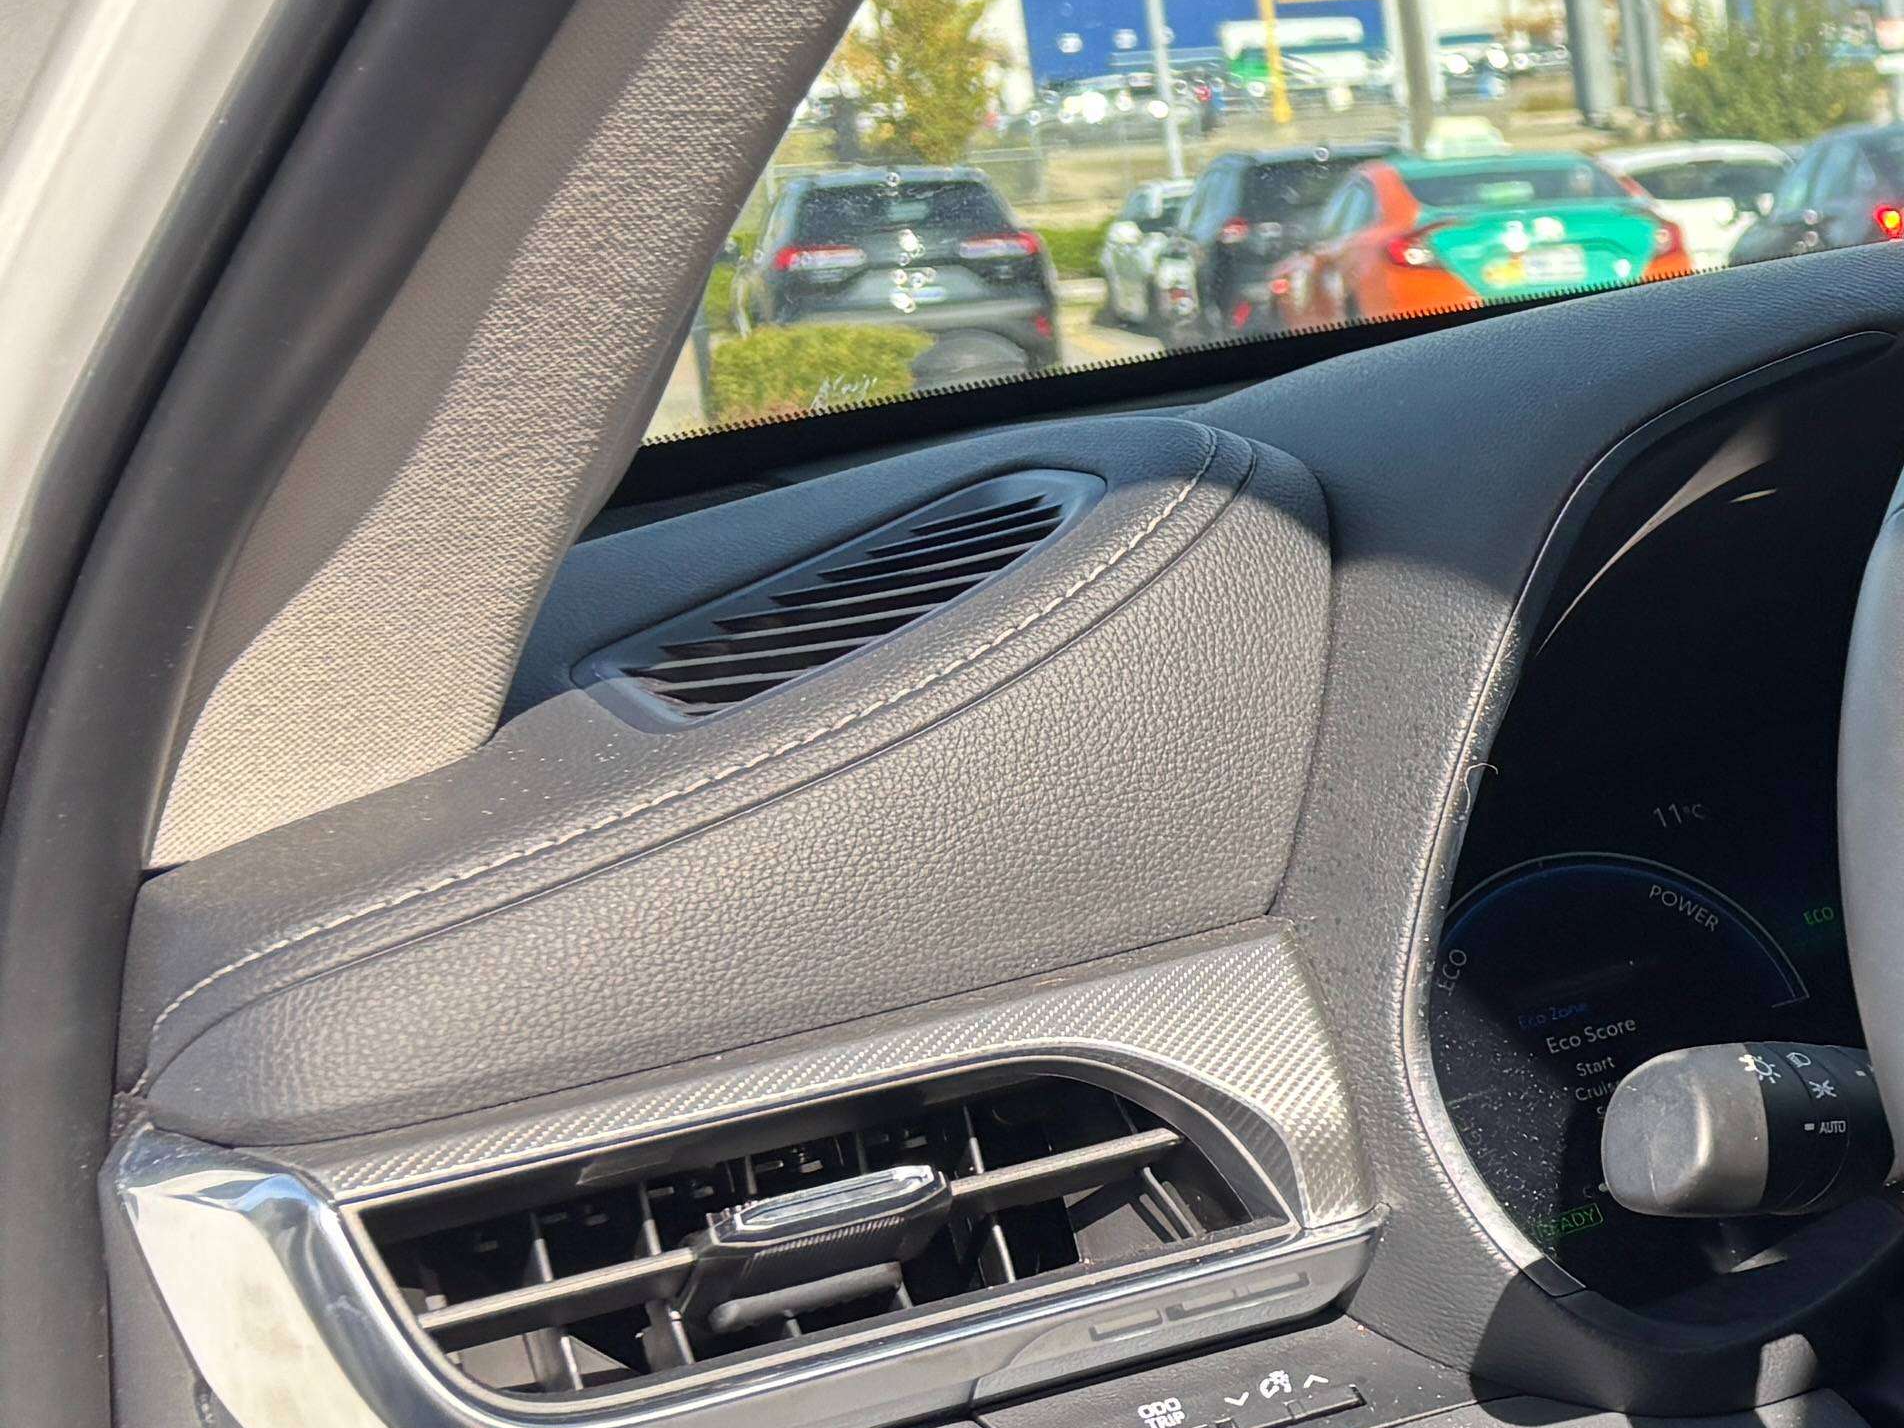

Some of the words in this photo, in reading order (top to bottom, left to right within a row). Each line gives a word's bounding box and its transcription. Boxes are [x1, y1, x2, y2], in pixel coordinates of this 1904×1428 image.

[1648, 883, 1719, 932] POWER
[1803, 905, 1834, 925] ECO
[1437, 948, 1467, 996] ECO
[1545, 1035, 1582, 1055] Eco
[1583, 1018, 1638, 1044] Score
[1575, 1055, 1617, 1078] Start
[1818, 1120, 1846, 1135] AUTO
